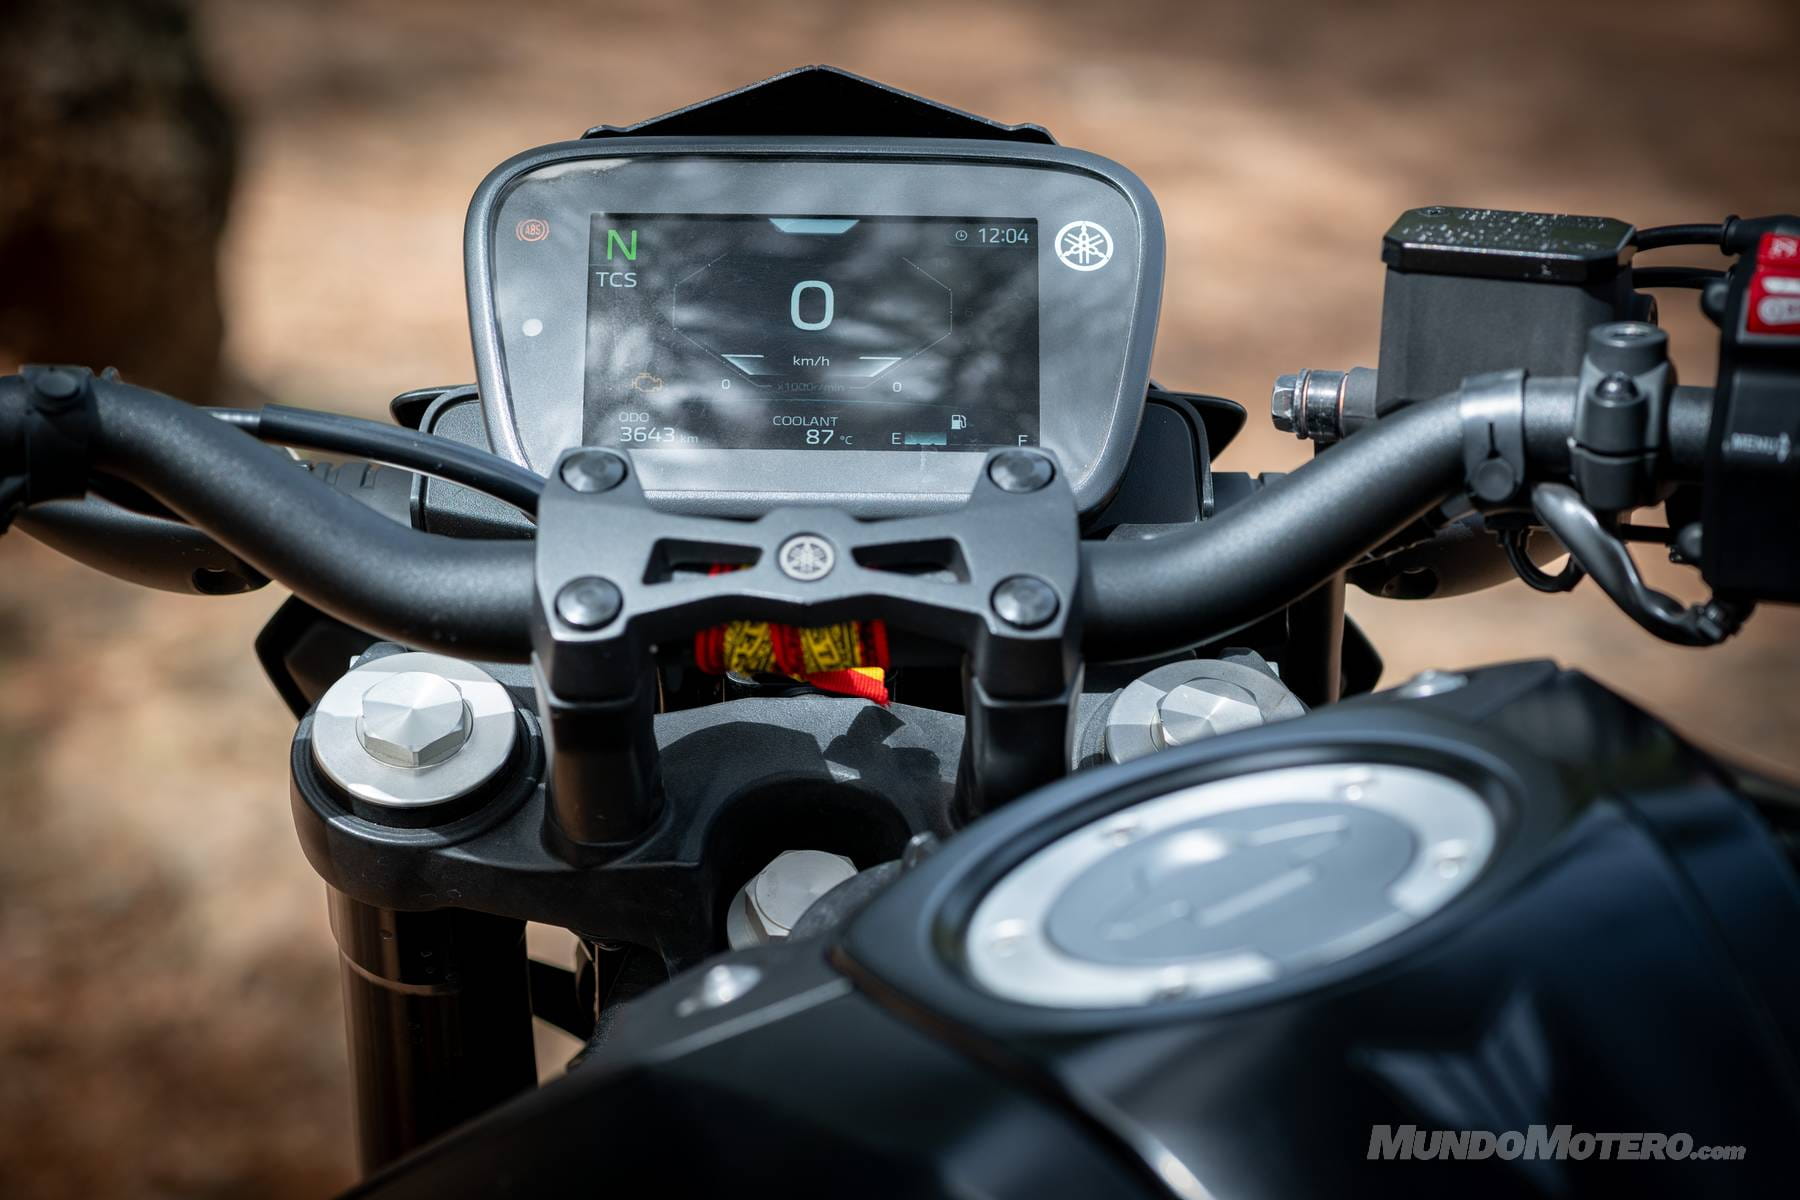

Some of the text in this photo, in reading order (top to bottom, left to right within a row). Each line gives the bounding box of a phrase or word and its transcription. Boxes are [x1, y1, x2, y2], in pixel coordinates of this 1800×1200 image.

[978, 227, 1030, 244] 12:04
[607, 229, 638, 260] N
[596, 271, 637, 288] TCS
[791, 280, 834, 331] 0
[793, 356, 830, 367] km/h
[721, 379, 731, 390] 0
[619, 412, 650, 423] ODO
[773, 415, 838, 427] COOLANT
[620, 427, 698, 443] 3643 km
[806, 429, 853, 445] 87 °C
[891, 432, 902, 445] E
[1018, 435, 1028, 446] F
